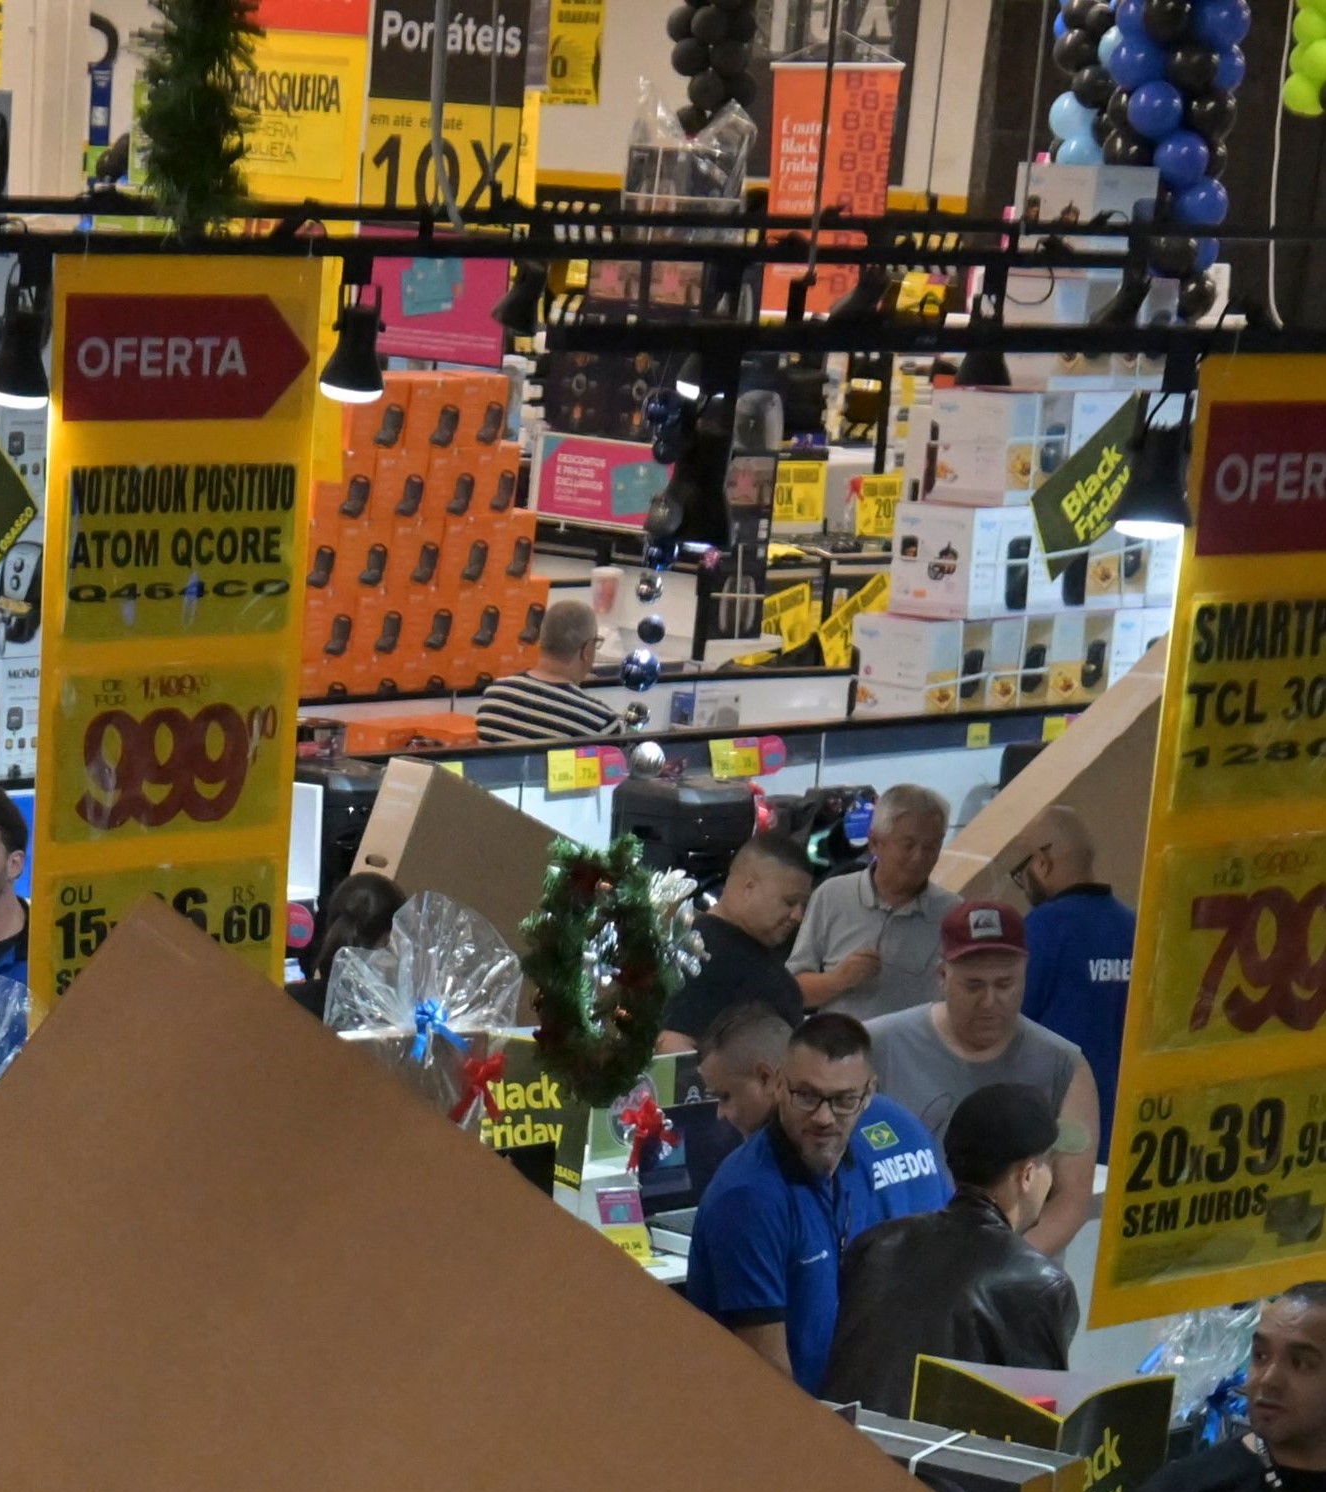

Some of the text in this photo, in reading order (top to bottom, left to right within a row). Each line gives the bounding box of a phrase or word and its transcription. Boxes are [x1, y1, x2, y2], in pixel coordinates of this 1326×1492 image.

[381, 10, 521, 57] Poráteis
[77, 336, 247, 379] OFERTA
[69, 463, 296, 515] NOTEBOOK POSITIVO
[1060, 444, 1124, 521] Black
[1215, 452, 1326, 502] OFER
[0, 505, 36, 552] OSASCO
[72, 526, 282, 569] ATOM QCORE
[8, 668, 40, 680] MOND
[1188, 677, 1267, 729] TCL
[60, 885, 93, 906] OU
[1089, 958, 1132, 983] VENDE
[481, 1115, 564, 1151] Friday
[1138, 1098, 1172, 1123] OU
[872, 1149, 938, 1191] ENDEDOR
[1123, 1182, 1271, 1238] SEM JUROS
[1083, 1426, 1124, 1492] ack
